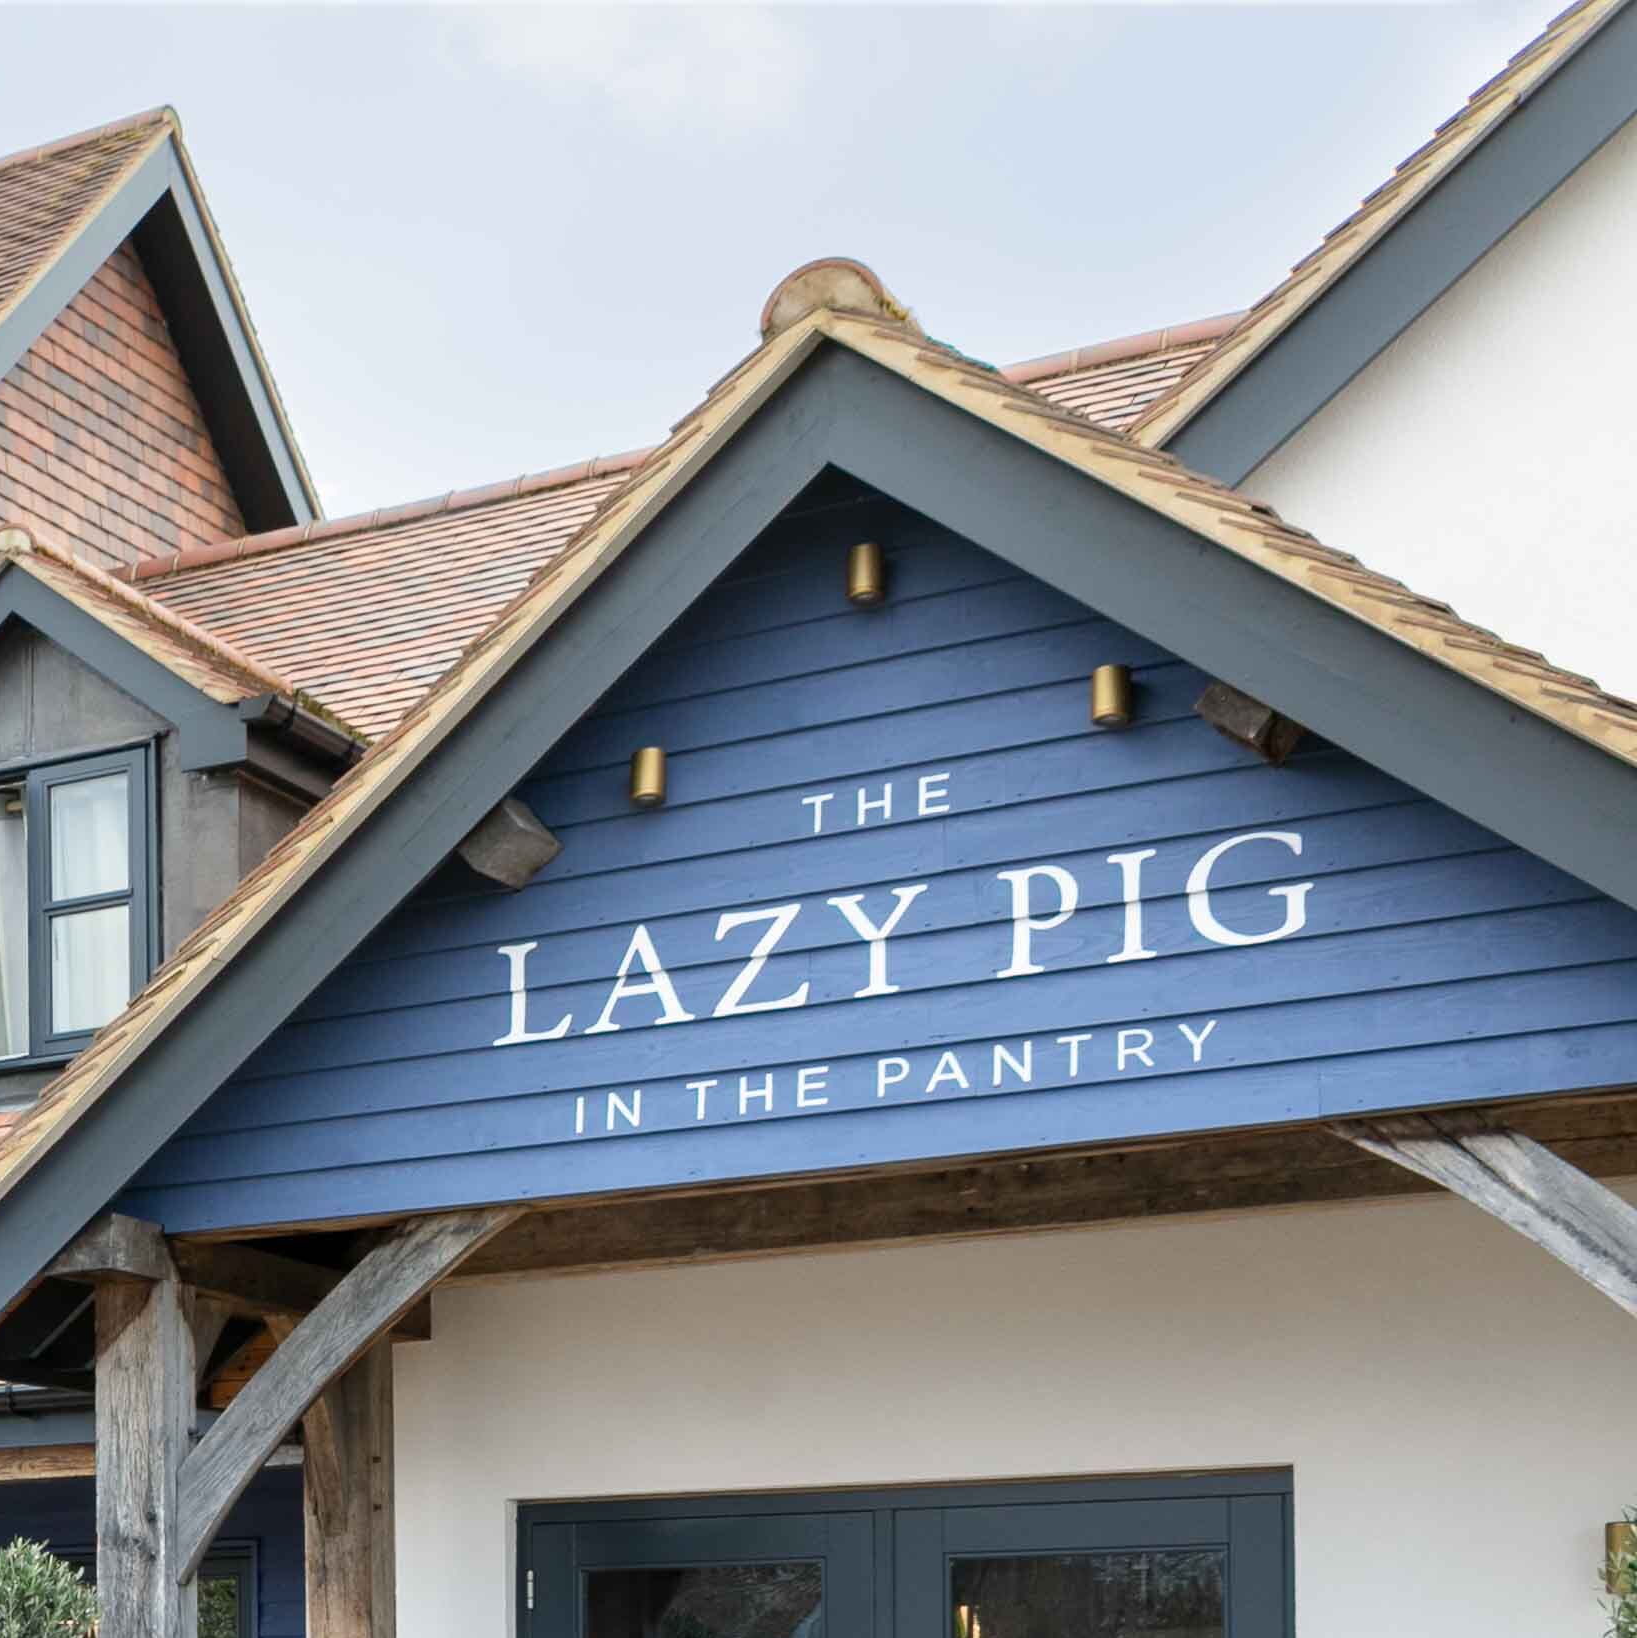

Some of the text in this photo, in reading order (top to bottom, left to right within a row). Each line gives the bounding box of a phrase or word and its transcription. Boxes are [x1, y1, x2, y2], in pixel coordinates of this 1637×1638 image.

[801, 773, 952, 836] THE
[491, 831, 1316, 1047] LAZY PIG
[574, 1019, 1219, 1137] IN THE PANTRY
